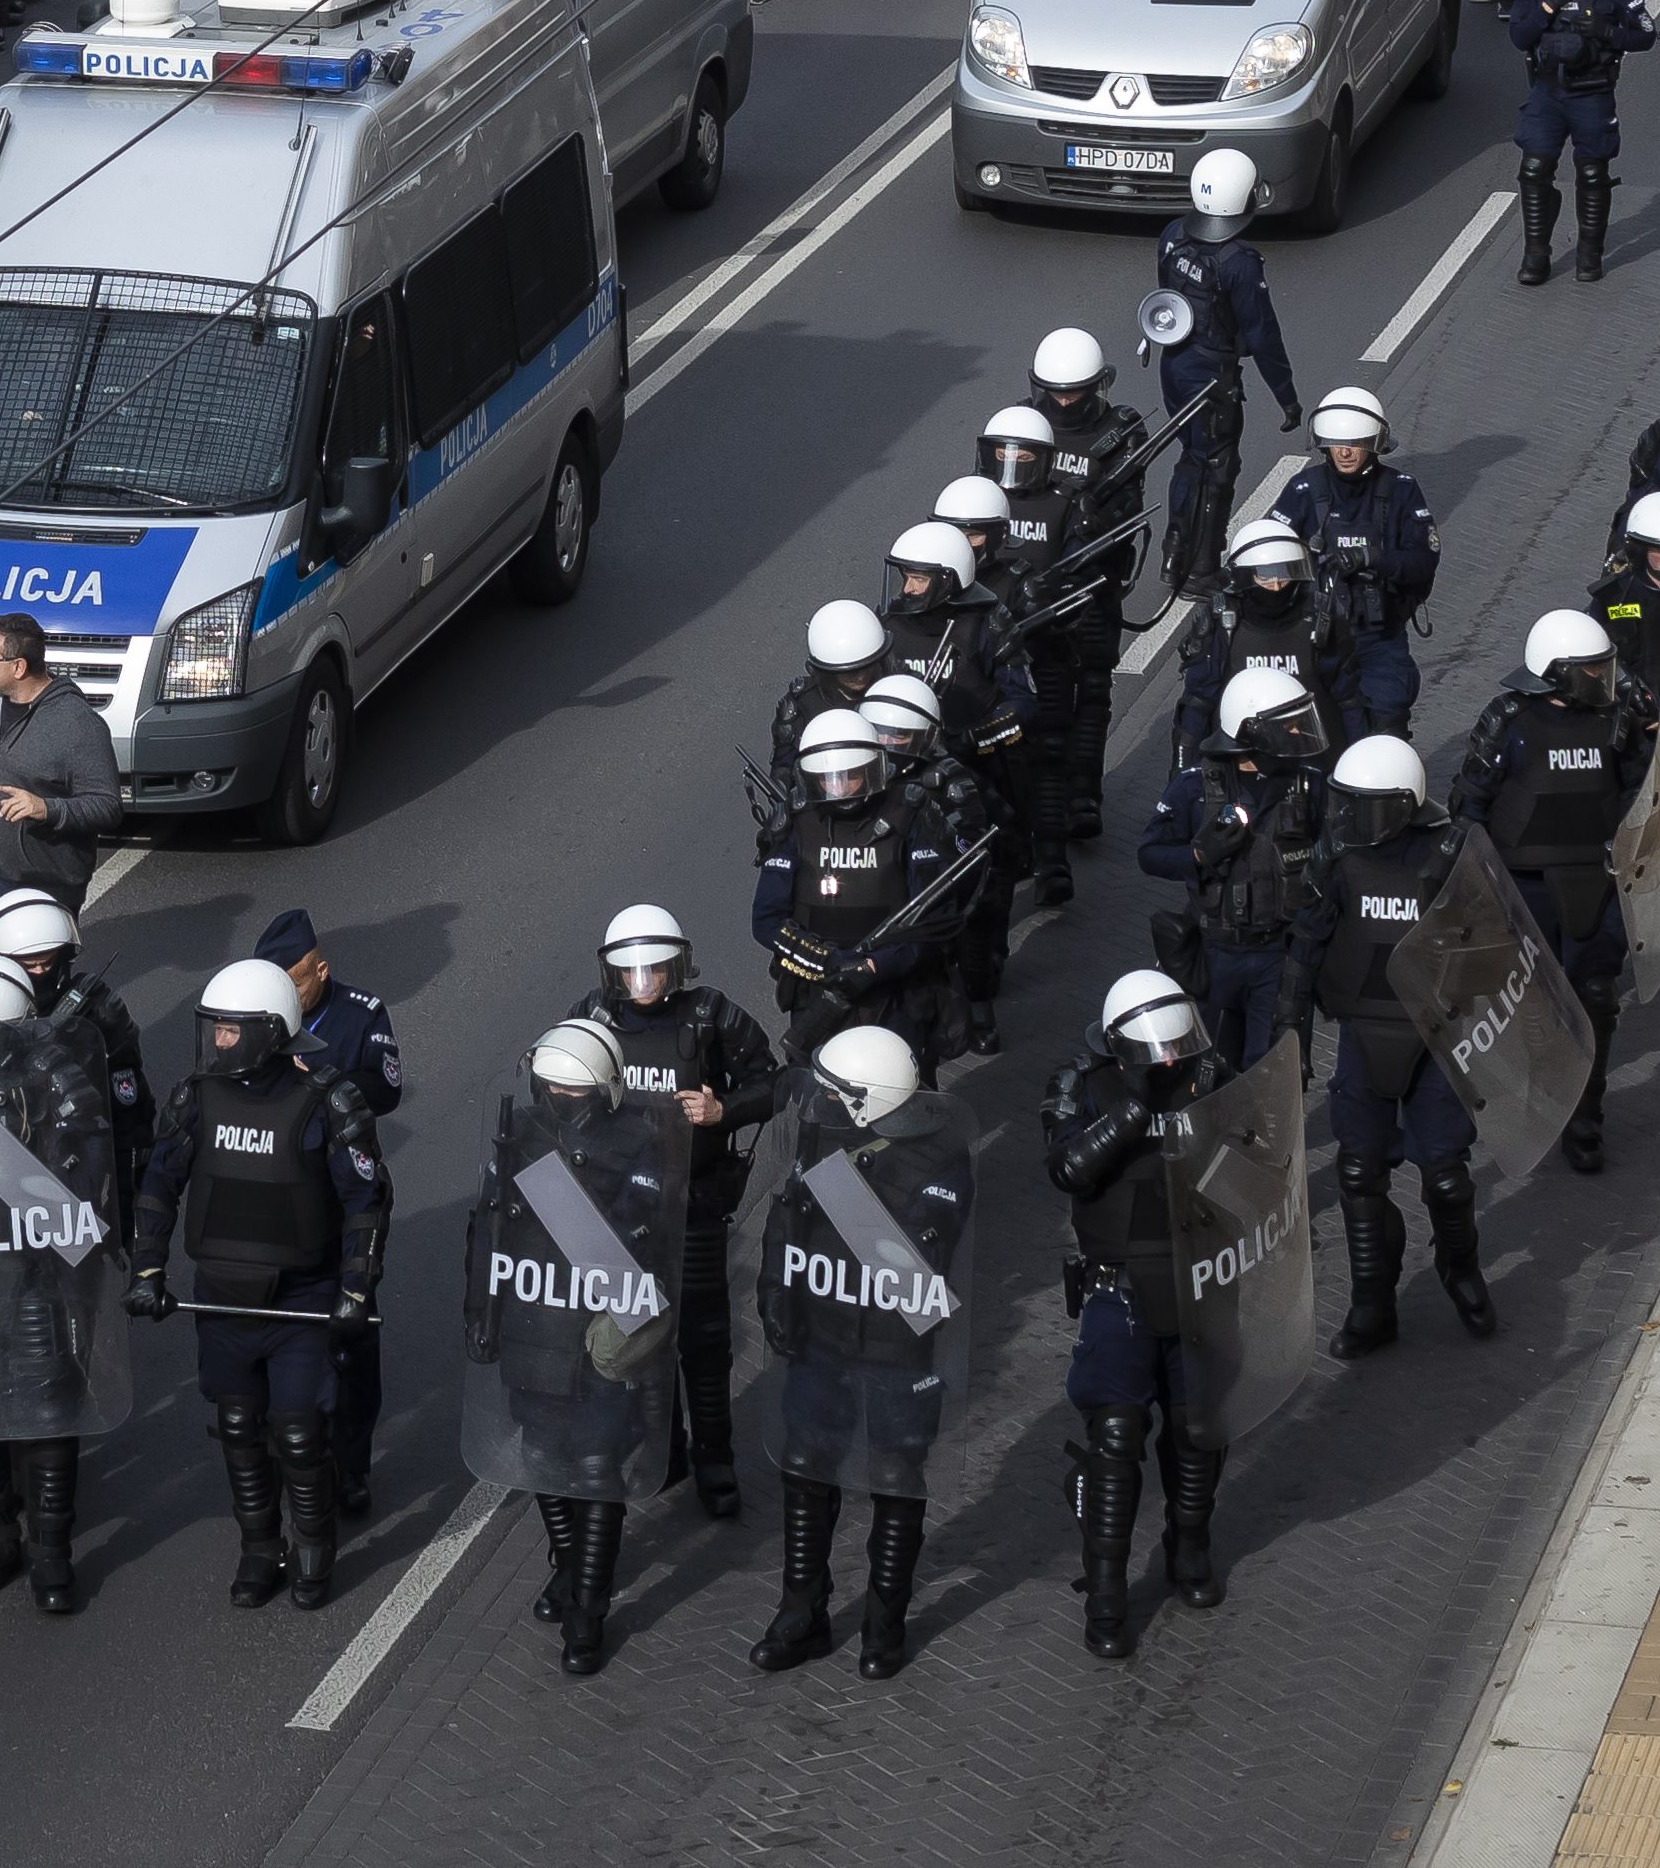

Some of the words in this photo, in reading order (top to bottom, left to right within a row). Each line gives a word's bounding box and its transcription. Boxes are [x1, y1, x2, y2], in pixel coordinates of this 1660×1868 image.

[86, 52, 209, 81] POLICJA
[1078, 148, 1115, 168] HPD
[1123, 154, 1170, 173] 07DA
[1201, 182, 1213, 196] M
[587, 286, 614, 339] D704
[439, 414, 489, 476] POLICJA
[1338, 535, 1368, 548] POLICJA
[1609, 605, 1640, 618] POLICJA
[1548, 747, 1602, 771] POLICJA
[819, 845, 878, 870] POLICJA
[1360, 895, 1419, 923] POLICJA
[1451, 934, 1541, 1075] POLICJA
[215, 1123, 275, 1155] POLICJA
[922, 1186, 958, 1203] POLICJA
[1192, 1186, 1303, 1301] POLICJA
[489, 1252, 661, 1318] POLICJA
[784, 1244, 951, 1319] POLICJA
